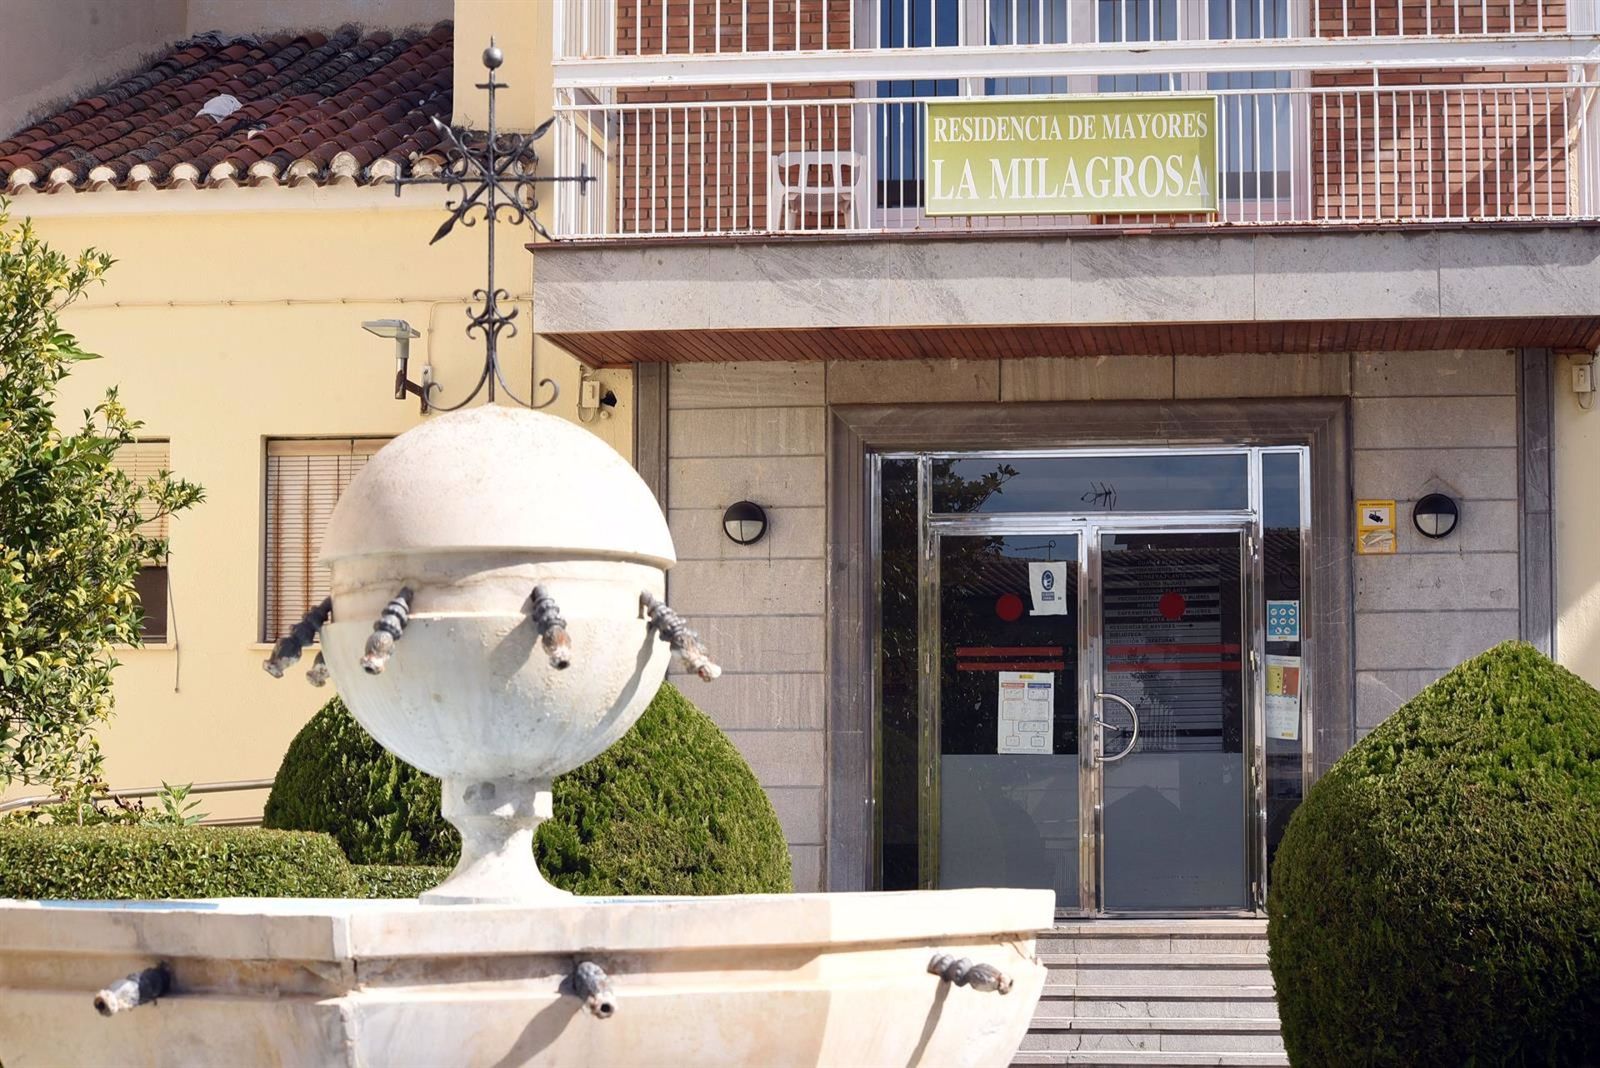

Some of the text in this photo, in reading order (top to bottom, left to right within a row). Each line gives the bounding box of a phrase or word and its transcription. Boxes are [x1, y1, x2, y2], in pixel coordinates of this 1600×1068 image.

[934, 112, 1209, 143] RESIDENCIA DE MAYORES
[931, 154, 1210, 201] LA MILAGROSA
